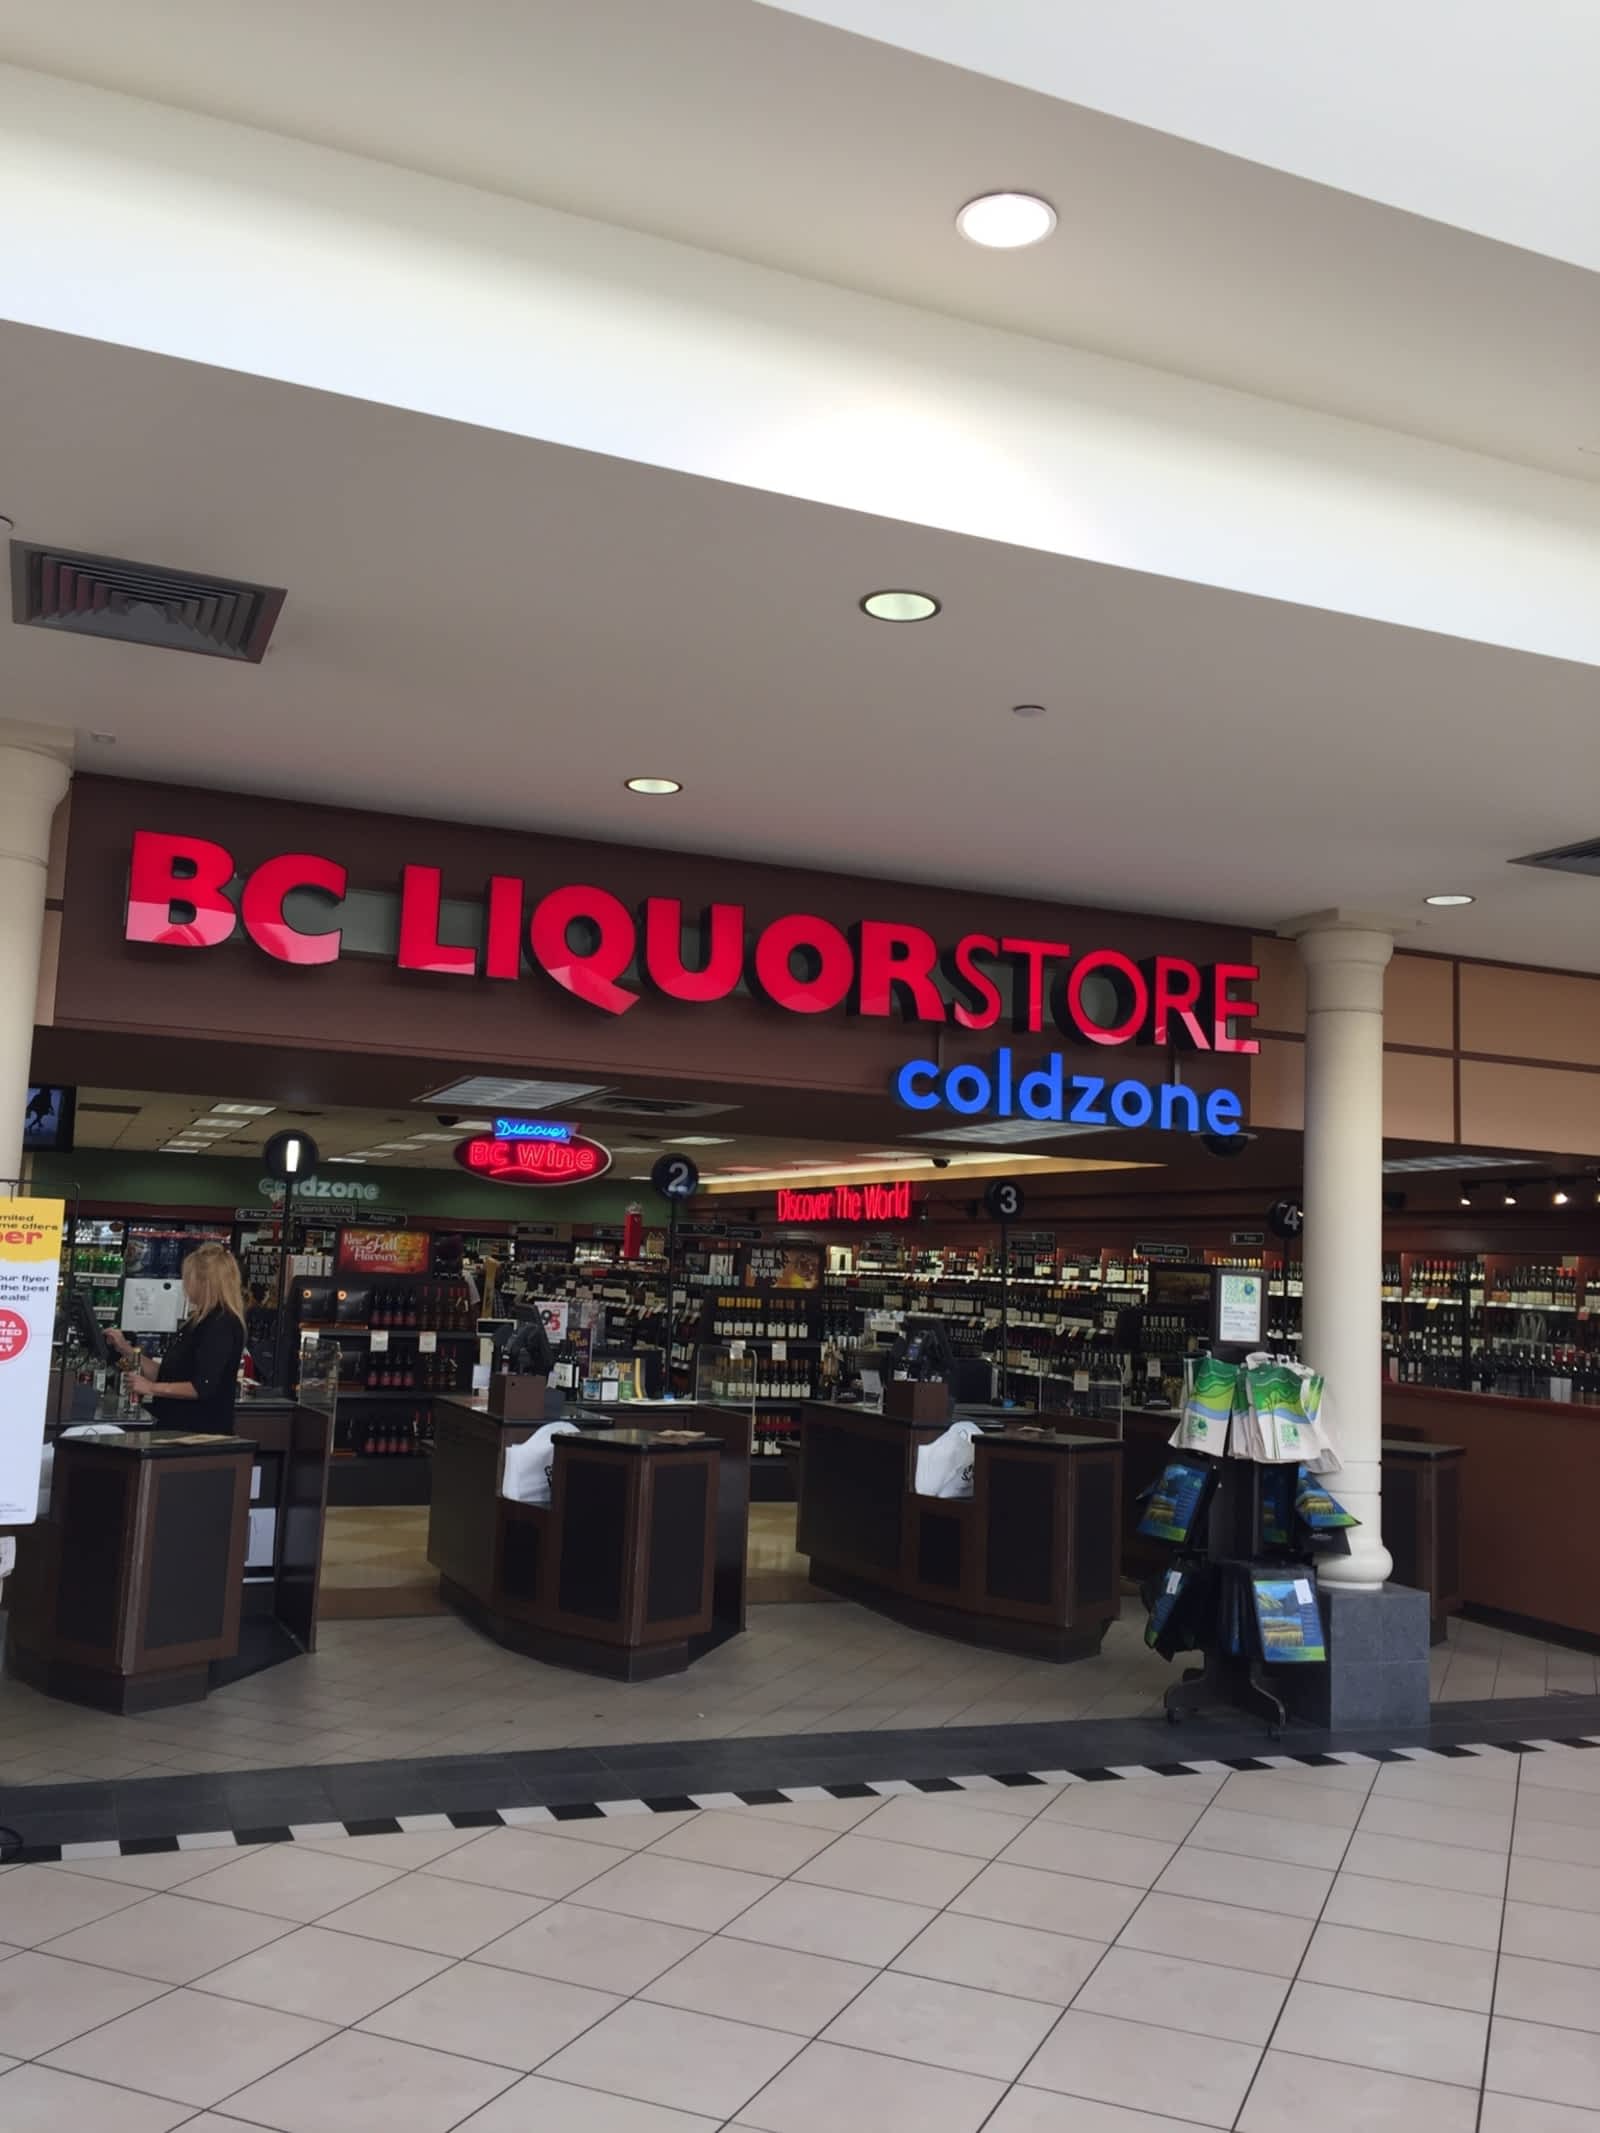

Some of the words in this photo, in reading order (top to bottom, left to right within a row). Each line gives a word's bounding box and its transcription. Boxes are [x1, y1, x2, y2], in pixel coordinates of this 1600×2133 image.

[125, 830, 348, 965] BC
[397, 864, 946, 1017] LIQUOR
[954, 934, 1261, 1054] STORE
[898, 1047, 1243, 1136] coldzone
[496, 1119, 569, 1138] Discover
[469, 1141, 508, 1166] BC
[668, 1162, 689, 1192] 2
[777, 1188, 833, 1222] Discover
[835, 1185, 862, 1220] The
[864, 1181, 911, 1220] World
[1000, 1186, 1018, 1214] 3
[22, 1223, 58, 1231] offers
[1283, 1206, 1300, 1230] 4
[1, 1284, 20, 1292] the
[23, 1285, 49, 1293] best
[22, 1274, 49, 1284] flyer
